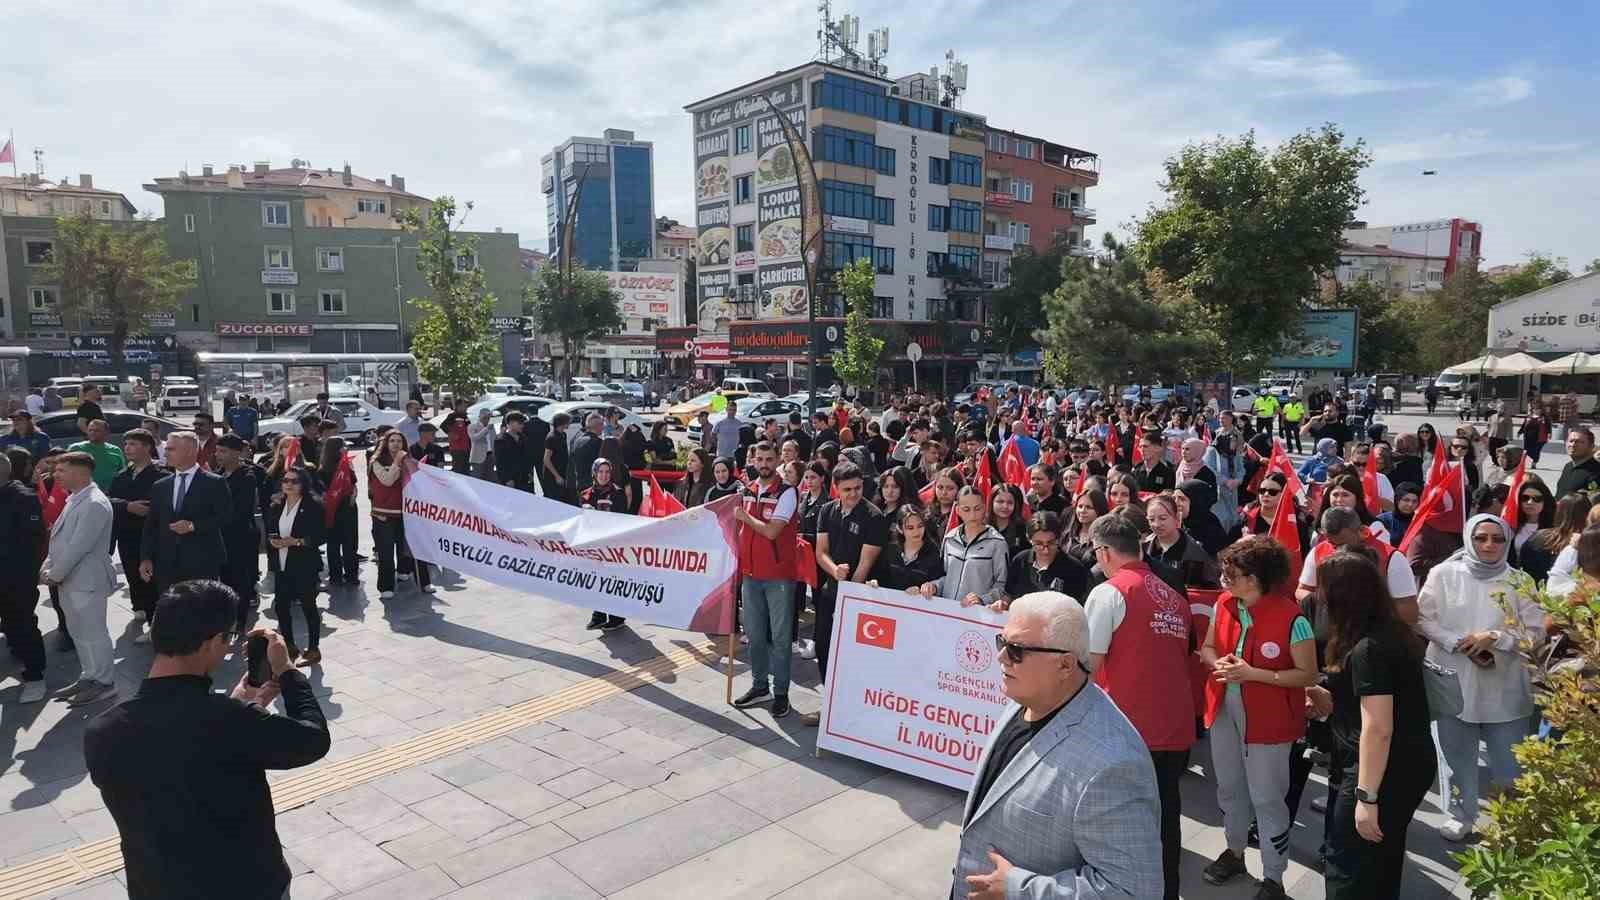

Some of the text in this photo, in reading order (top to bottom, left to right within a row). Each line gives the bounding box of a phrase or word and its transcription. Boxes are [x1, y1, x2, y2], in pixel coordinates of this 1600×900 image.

[910, 135, 918, 223] KÖROĞLU
[438, 537, 665, 607] 19 EYLÜL GAZİLER GÜNÜ YÜRÜYÜŞÜ
[631, 546, 708, 573] YOLUNDA
[937, 681, 960, 695] SPOR
[962, 688, 1009, 706] BAKANLIĞ
[956, 675, 995, 692] GENÇLİK
[864, 688, 920, 717] NİĞDE
[897, 722, 912, 745] İL
